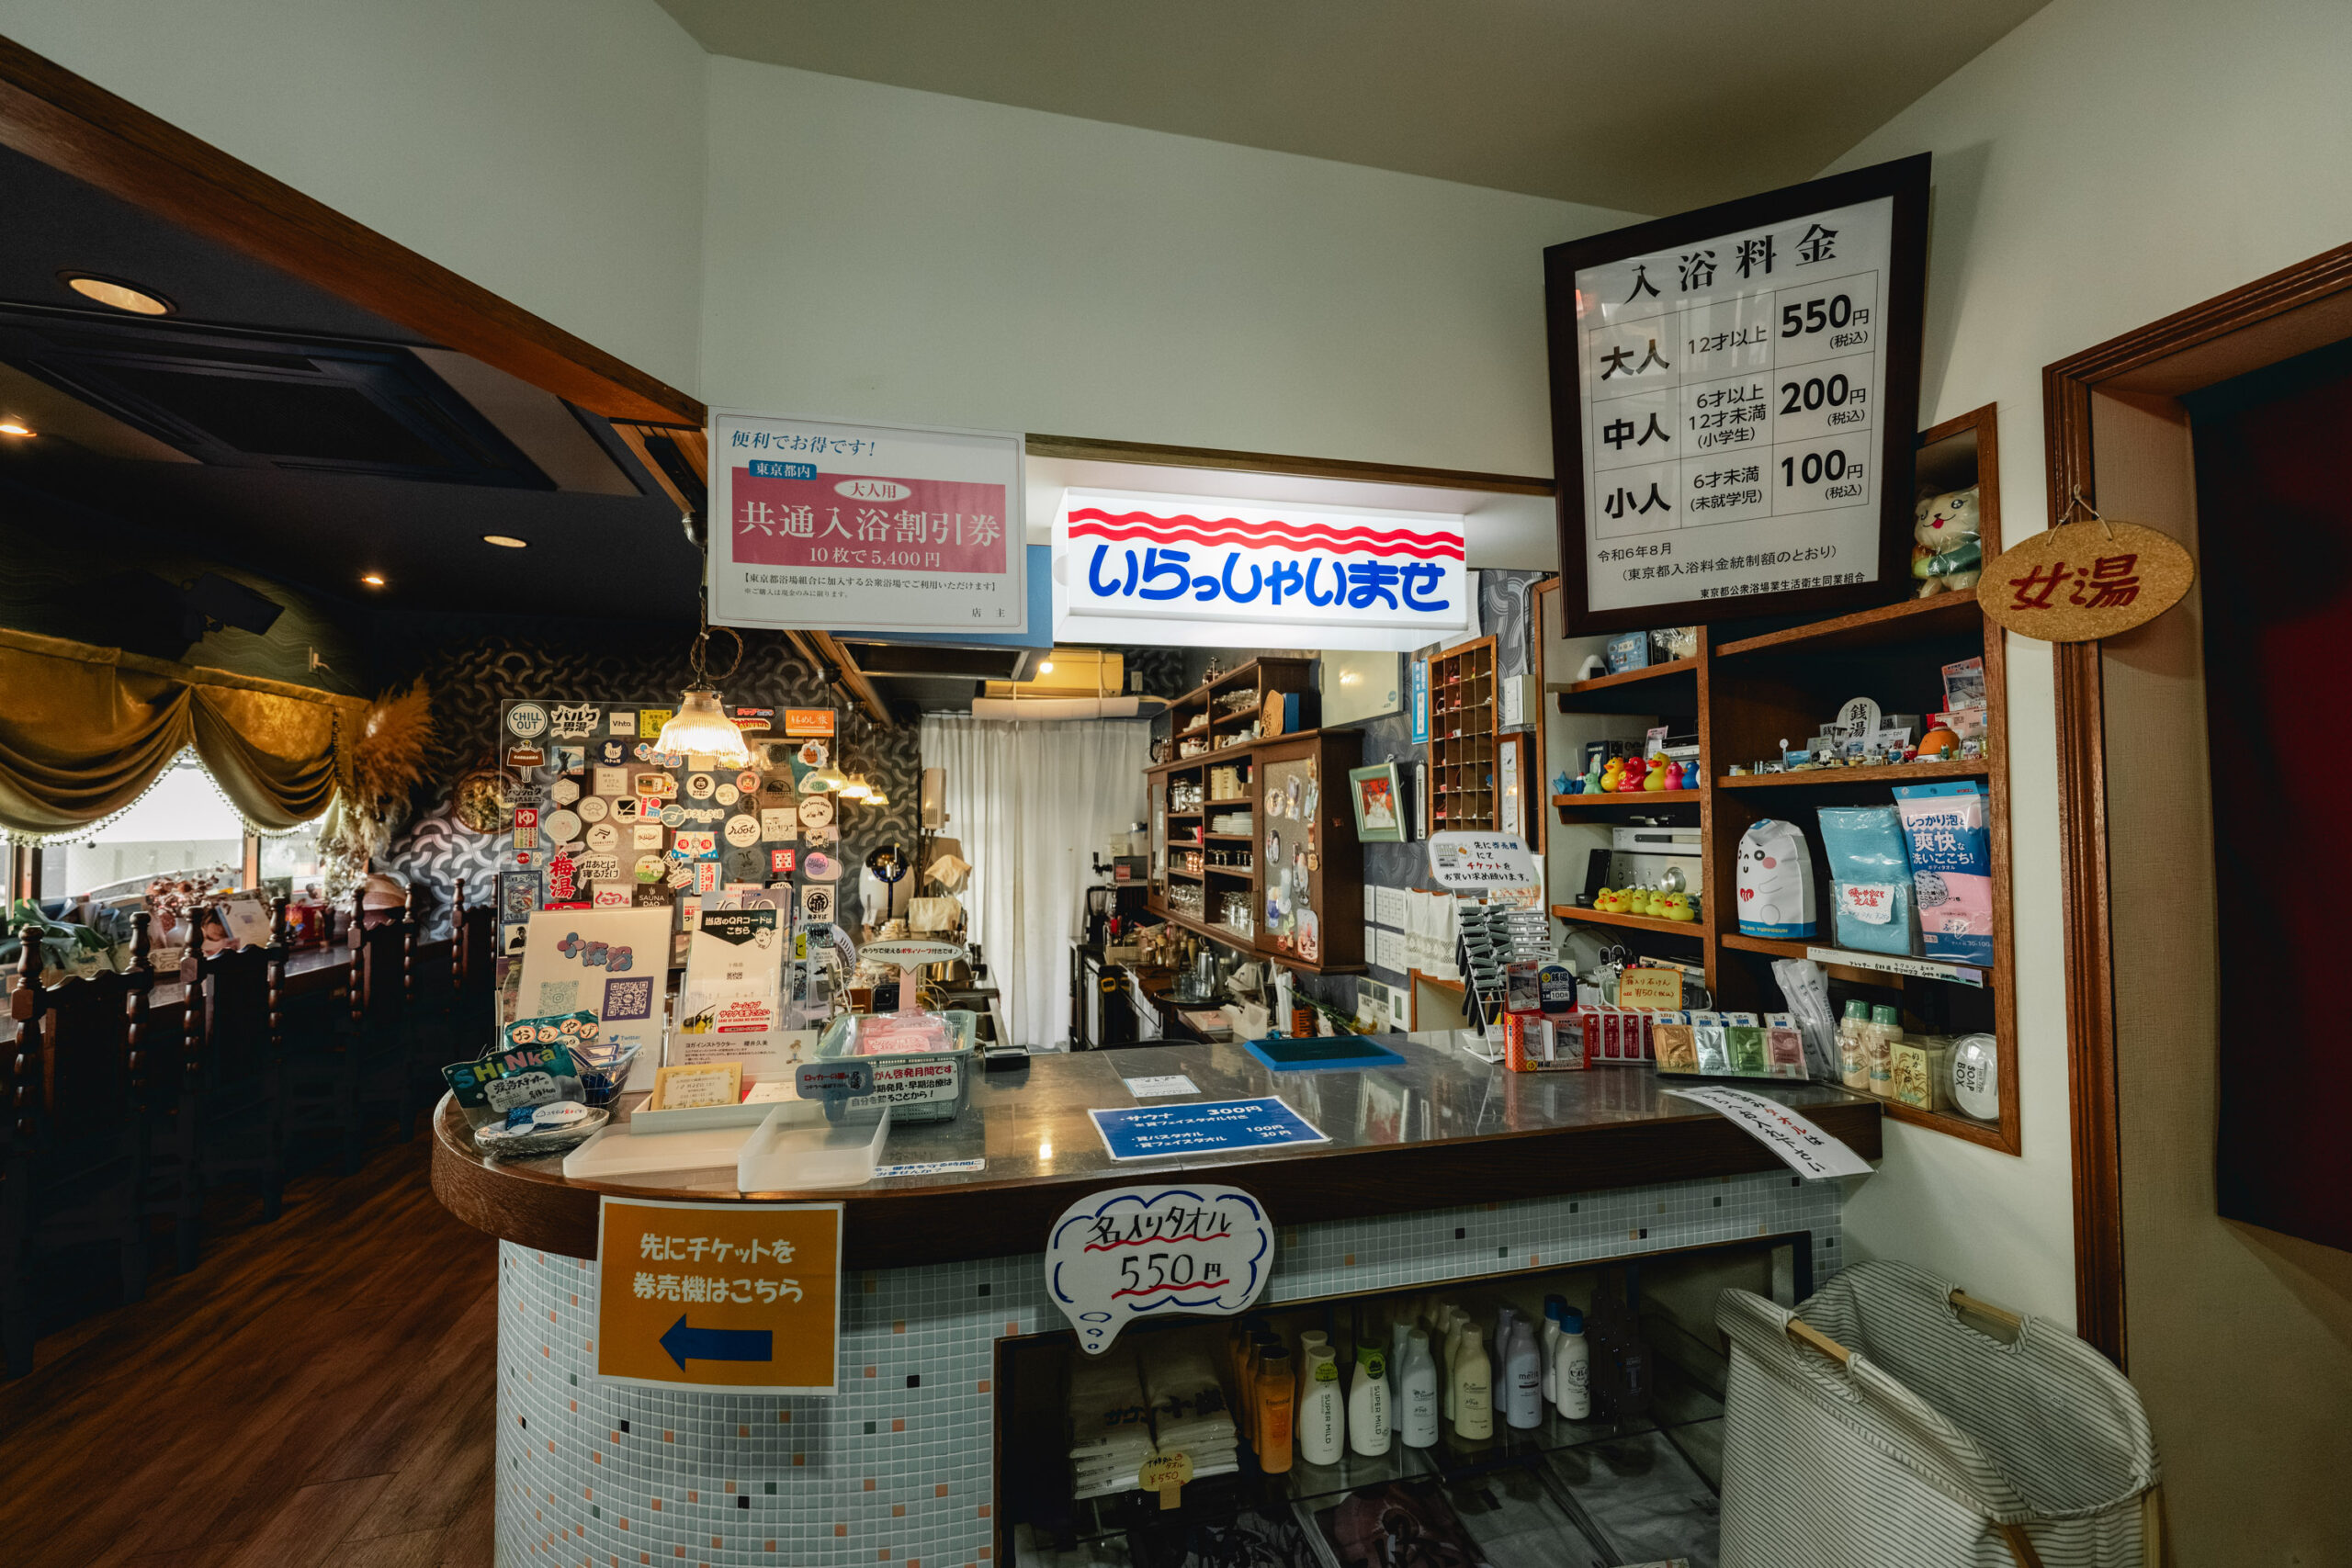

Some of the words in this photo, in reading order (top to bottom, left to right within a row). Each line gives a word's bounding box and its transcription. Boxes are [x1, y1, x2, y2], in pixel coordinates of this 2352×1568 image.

[1623, 223, 1838, 304] 入浴料金
[1781, 294, 1870, 338] 550円
[1829, 330, 1869, 350] (税込)
[1600, 339, 1670, 381] 大人
[1688, 326, 1768, 355] 12才以上
[1696, 384, 1765, 408] 6才以上
[1779, 373, 1867, 415] 200円
[1688, 404, 1767, 431] 12才未満
[1826, 410, 1865, 428] (税込)
[731, 429, 876, 457] 便利でお得です!
[1603, 412, 1671, 451] 中人
[1697, 427, 1756, 448] (小学生)
[756, 462, 811, 479] 東京都内
[1693, 466, 1760, 489] 6才未満
[1781, 449, 1864, 488] 100円
[851, 482, 897, 499] 大人用
[1604, 483, 1671, 520] 小人
[1690, 490, 1763, 513] (未就学児)
[1825, 484, 1862, 501] (税込)
[738, 501, 1001, 547] 共通入浴割引券
[809, 547, 941, 568] 10枚で5,400円
[1597, 542, 1673, 563] 令和6年8月
[1088, 544, 1450, 612] いらっしゃいませ
[2009, 554, 2140, 610] 女湯
[512, 712, 542, 721] CHILL
[516, 721, 537, 730] OUT
[1849, 703, 1868, 739] 銭湯
[517, 810, 536, 826] ゆ
[728, 825, 756, 835] root
[1913, 831, 1965, 852] 爽快な
[1466, 862, 1511, 871] チケットを
[1912, 852, 1975, 864] 洗いごこち!
[727, 927, 751, 935] こちら
[873, 1066, 957, 1080] がん啓発月間です。
[1956, 1062, 1966, 1088] BOX
[1967, 1066, 1975, 1091] SOAP
[1207, 1105, 1263, 1116] 300円
[1085, 1206, 1232, 1245] 名入りタオル
[639, 1233, 796, 1263] 先にチケットを
[1120, 1253, 1222, 1292] 550円
[633, 1271, 803, 1303] 券売機はこちら
